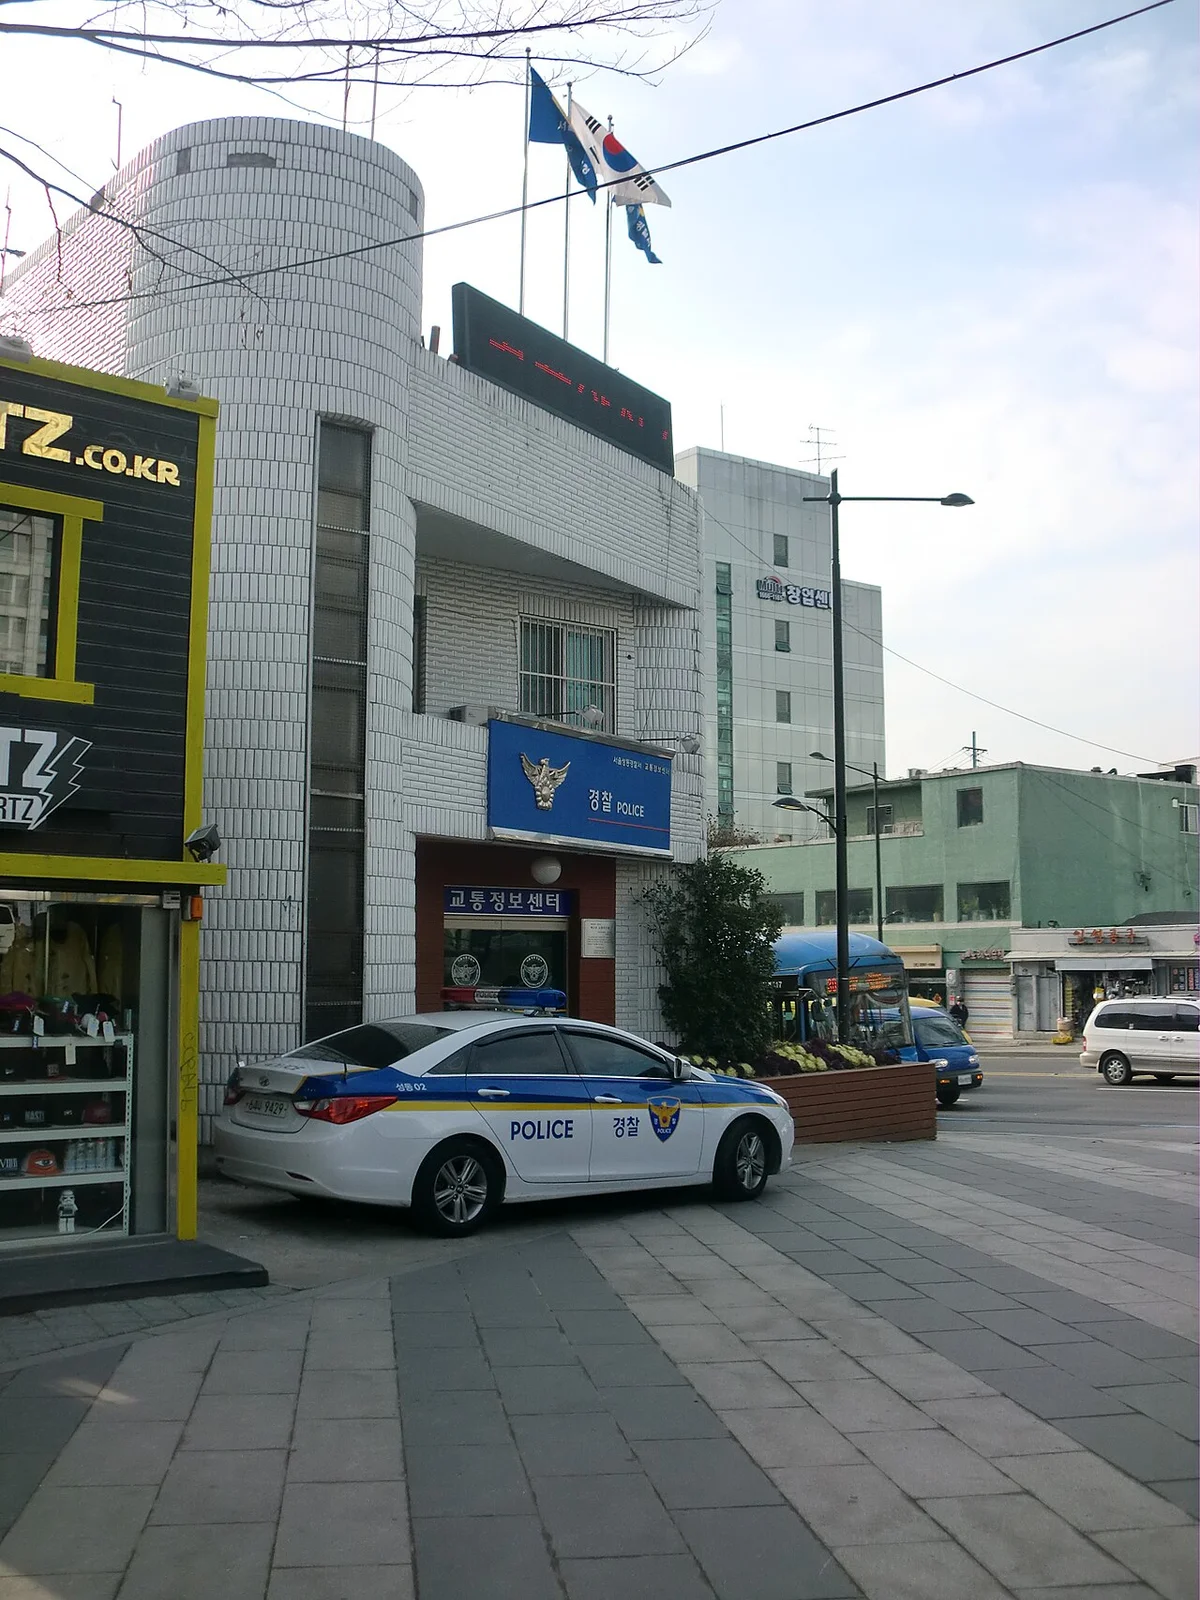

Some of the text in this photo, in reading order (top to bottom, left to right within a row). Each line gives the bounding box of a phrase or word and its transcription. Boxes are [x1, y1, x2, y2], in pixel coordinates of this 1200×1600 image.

[589, 789, 645, 818] 경찰 POLICE
[449, 890, 561, 913] 교통정보센터
[511, 1119, 574, 1141] POLICE
[613, 1116, 640, 1138] 경찰
